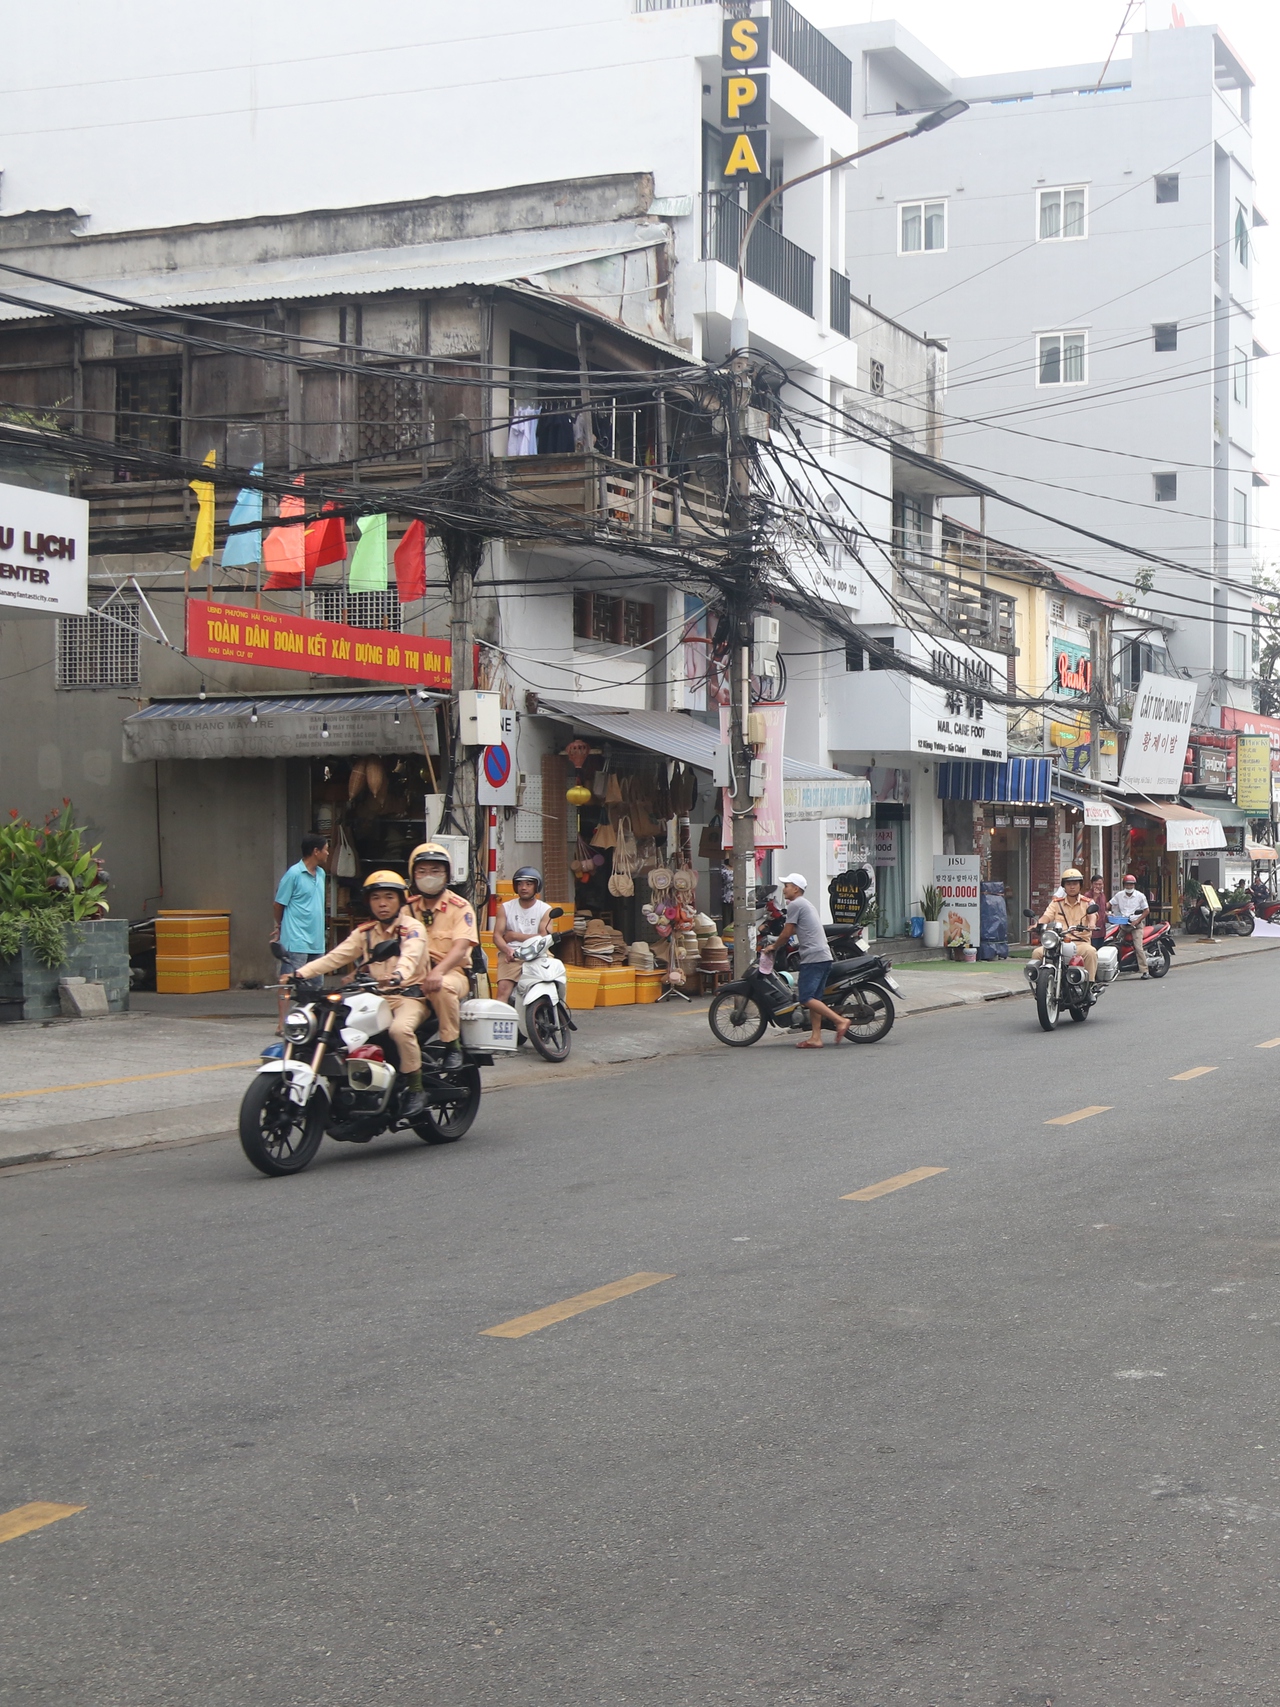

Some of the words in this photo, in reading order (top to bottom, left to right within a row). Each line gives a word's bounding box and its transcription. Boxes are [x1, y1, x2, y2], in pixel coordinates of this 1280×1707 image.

[724, 20, 761, 176] SPA
[24, 531, 76, 562] LỊCH
[207, 606, 222, 614] UBND
[225, 608, 248, 619] PHƯỜNG
[207, 620, 239, 645] TOÀN
[245, 625, 269, 649] DÂN
[274, 630, 303, 654] ĐOÀN
[307, 632, 327, 657] KẾT
[332, 638, 351, 660] XÂY
[355, 643, 383, 666] DỰNG
[387, 646, 400, 667] ĐÔ
[405, 650, 419, 673] THỊ
[423, 650, 441, 673] VĂN
[222, 648, 234, 657] DÂN
[1140, 686, 1154, 719] CẮT
[1152, 693, 1165, 721] TÓC
[253, 720, 274, 729] TRE
[971, 725, 986, 739] FOOT
[1184, 826, 1193, 836] XIN
[848, 833, 857, 845] Art
[948, 858, 966, 866] JISU
